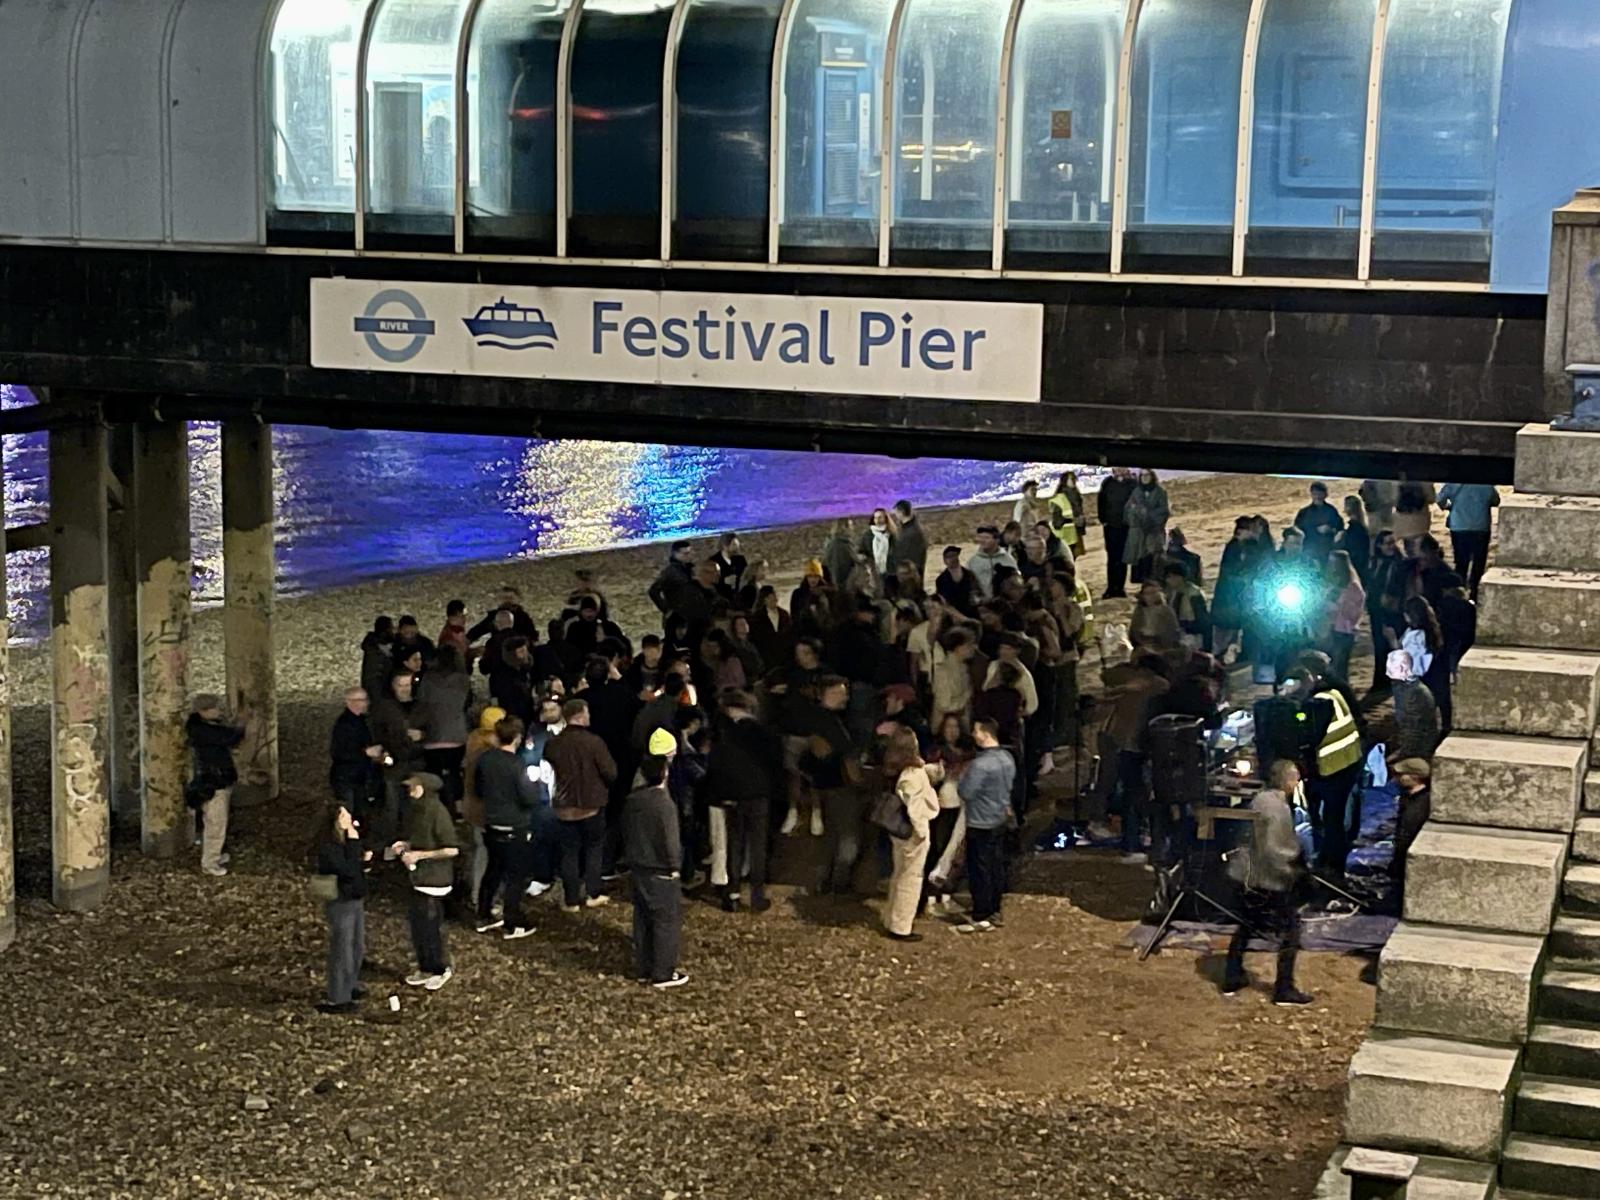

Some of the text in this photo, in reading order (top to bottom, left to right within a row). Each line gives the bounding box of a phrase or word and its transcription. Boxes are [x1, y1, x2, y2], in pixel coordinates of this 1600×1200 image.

[379, 321, 409, 331] RIVER
[592, 301, 986, 371] Festival Pier
